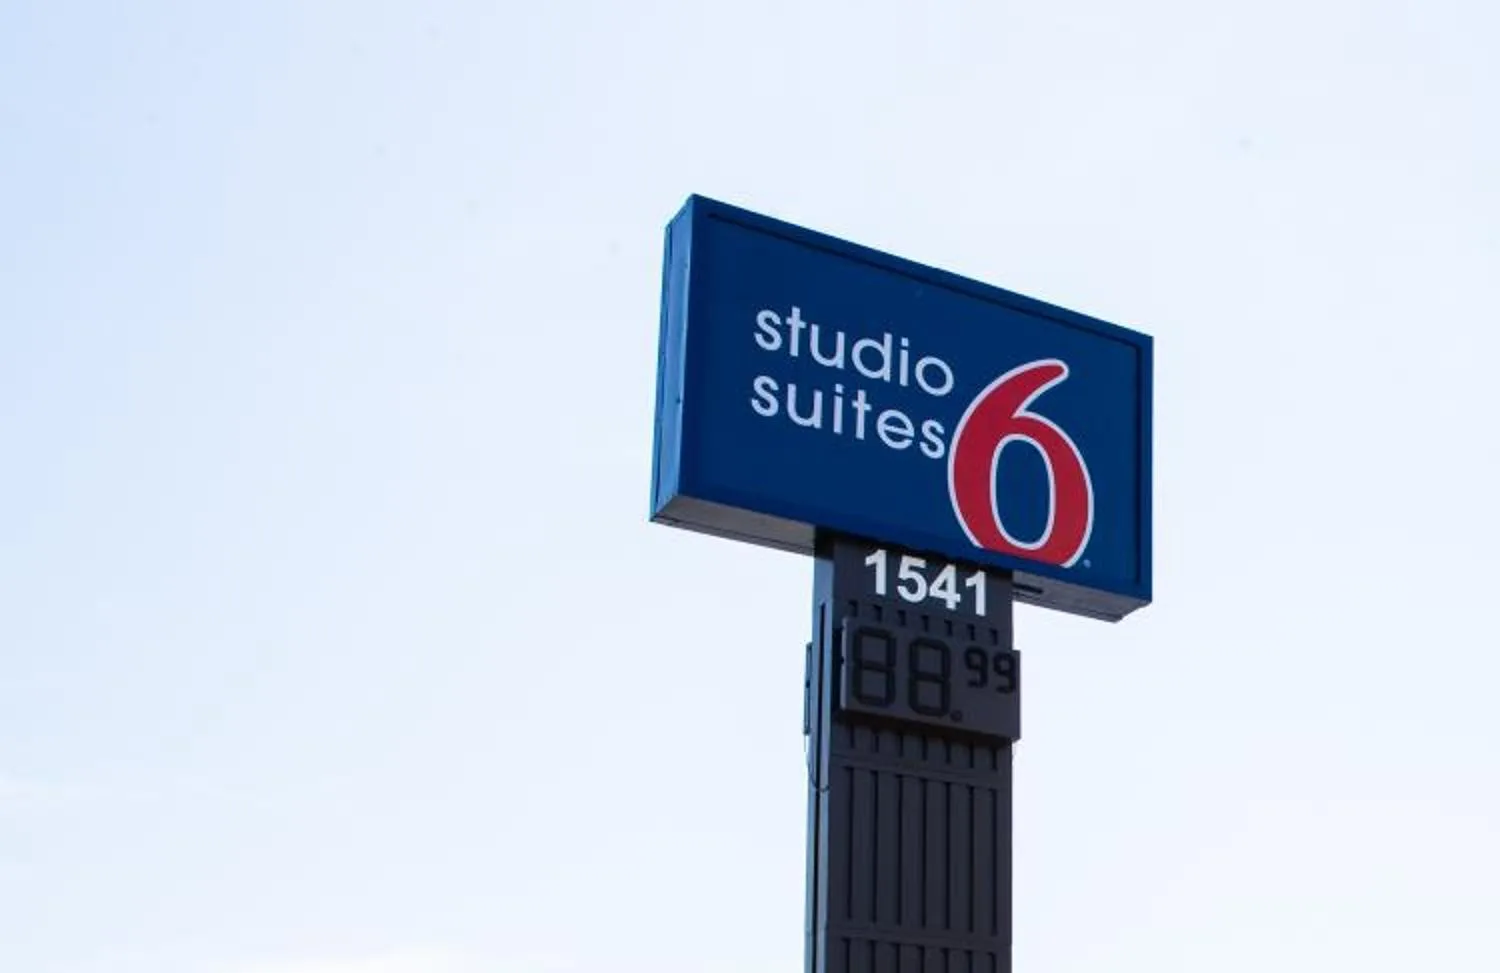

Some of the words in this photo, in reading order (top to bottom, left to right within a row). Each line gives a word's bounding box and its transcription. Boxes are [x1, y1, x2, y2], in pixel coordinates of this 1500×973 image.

[754, 306, 954, 396] studio
[751, 375, 946, 459] suites
[948, 358, 1094, 568] 6
[865, 549, 986, 616] 1541
